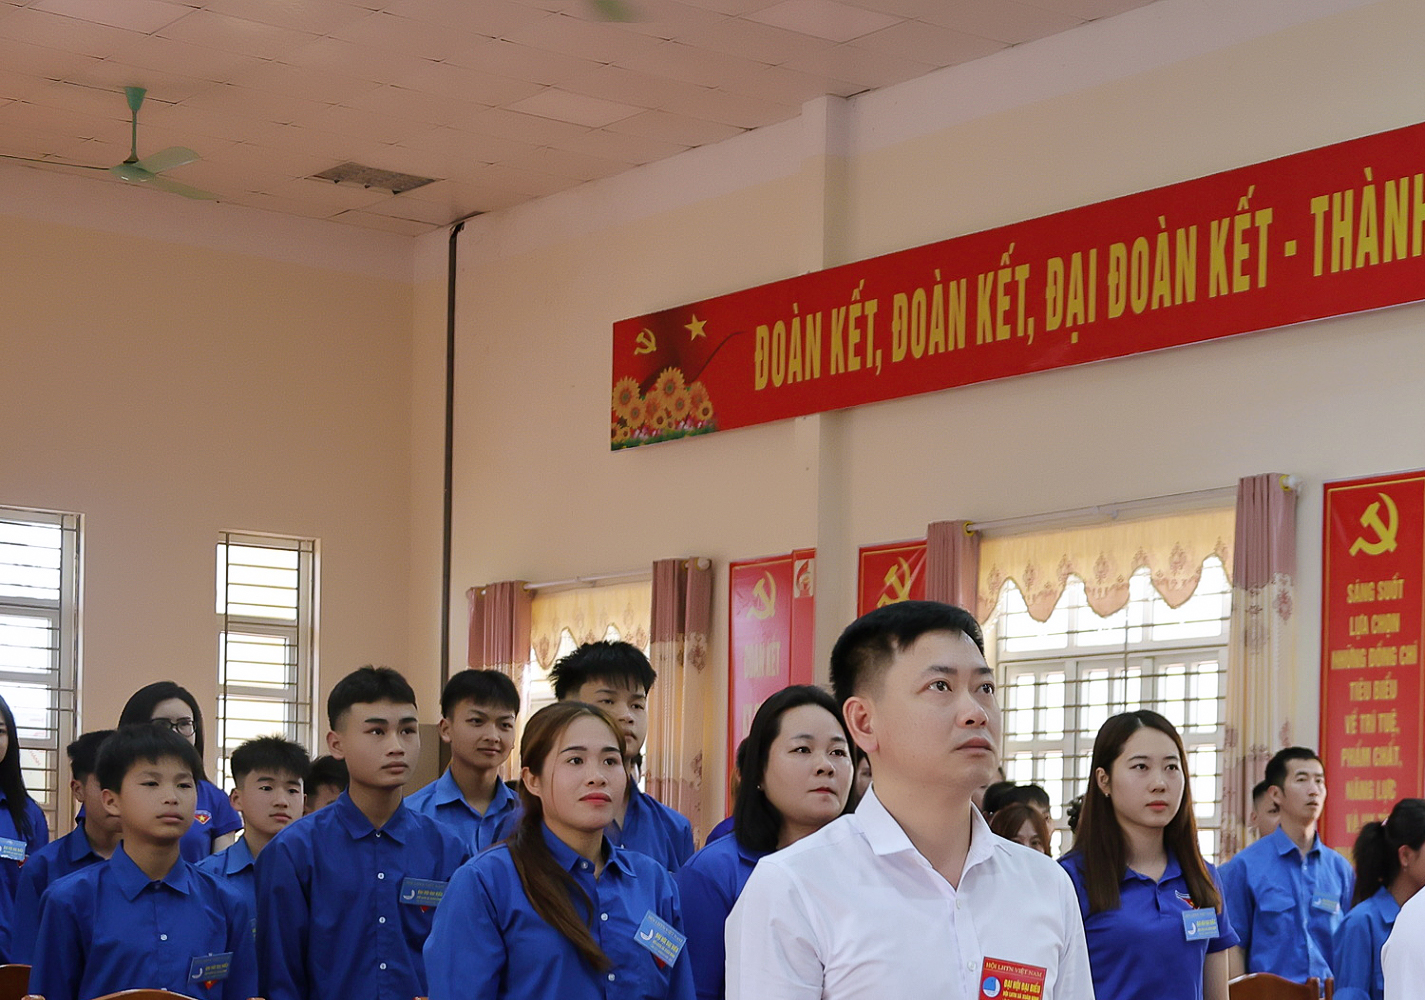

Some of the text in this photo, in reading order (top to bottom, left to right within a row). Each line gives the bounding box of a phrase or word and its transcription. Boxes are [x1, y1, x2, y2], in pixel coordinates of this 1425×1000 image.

[754, 303, 822, 390] ĐOÀN
[830, 279, 882, 374] KẾT,
[892, 269, 966, 363] ĐOÀN
[976, 242, 1034, 344] KẾT,
[1045, 247, 1097, 344] ĐẠI
[1107, 215, 1197, 318] ĐOÀN
[1208, 185, 1273, 297] KẾT
